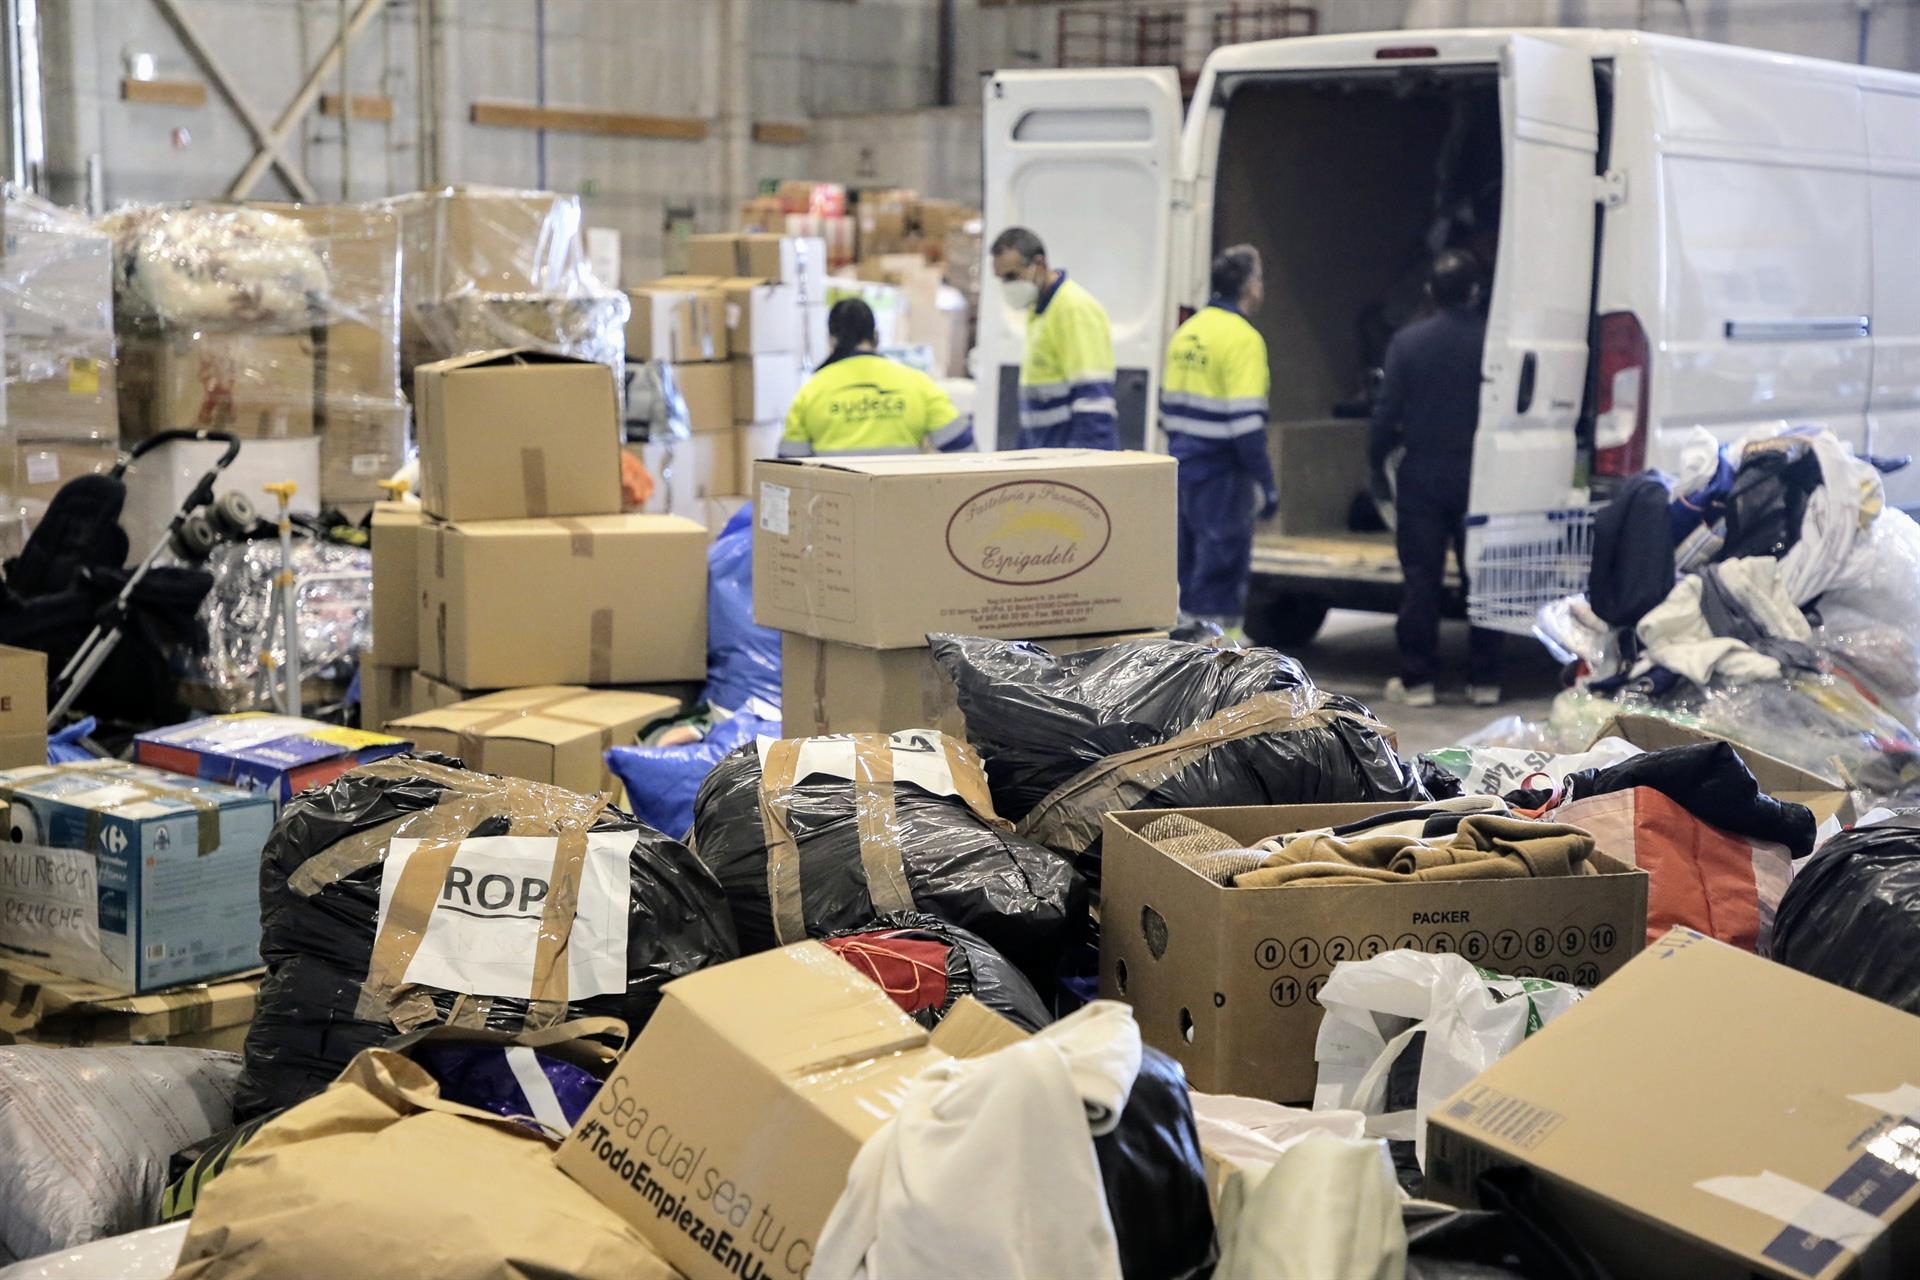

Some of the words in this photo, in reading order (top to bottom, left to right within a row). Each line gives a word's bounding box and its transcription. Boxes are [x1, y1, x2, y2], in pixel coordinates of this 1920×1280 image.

[981, 542, 1078, 575] Espigadeli
[5, 898, 84, 930] PELUCHE
[1413, 911, 1470, 924] PACKER
[1265, 945, 1276, 962] 0
[1333, 943, 1345, 961] 2
[1468, 937, 1480, 955] 6
[1502, 937, 1513, 954] 7
[1535, 935, 1546, 952] 8
[1566, 933, 1577, 950] 9
[1593, 930, 1614, 948] 10
[1274, 983, 1295, 1000] 11
[1577, 969, 1597, 986] 20
[599, 1076, 649, 1140] Sea
[646, 1124, 706, 1186] cual
[696, 1168, 753, 1229] sea
[752, 1204, 786, 1254] tu
[577, 1118, 773, 1280] #TodoEmpiezaEnU
